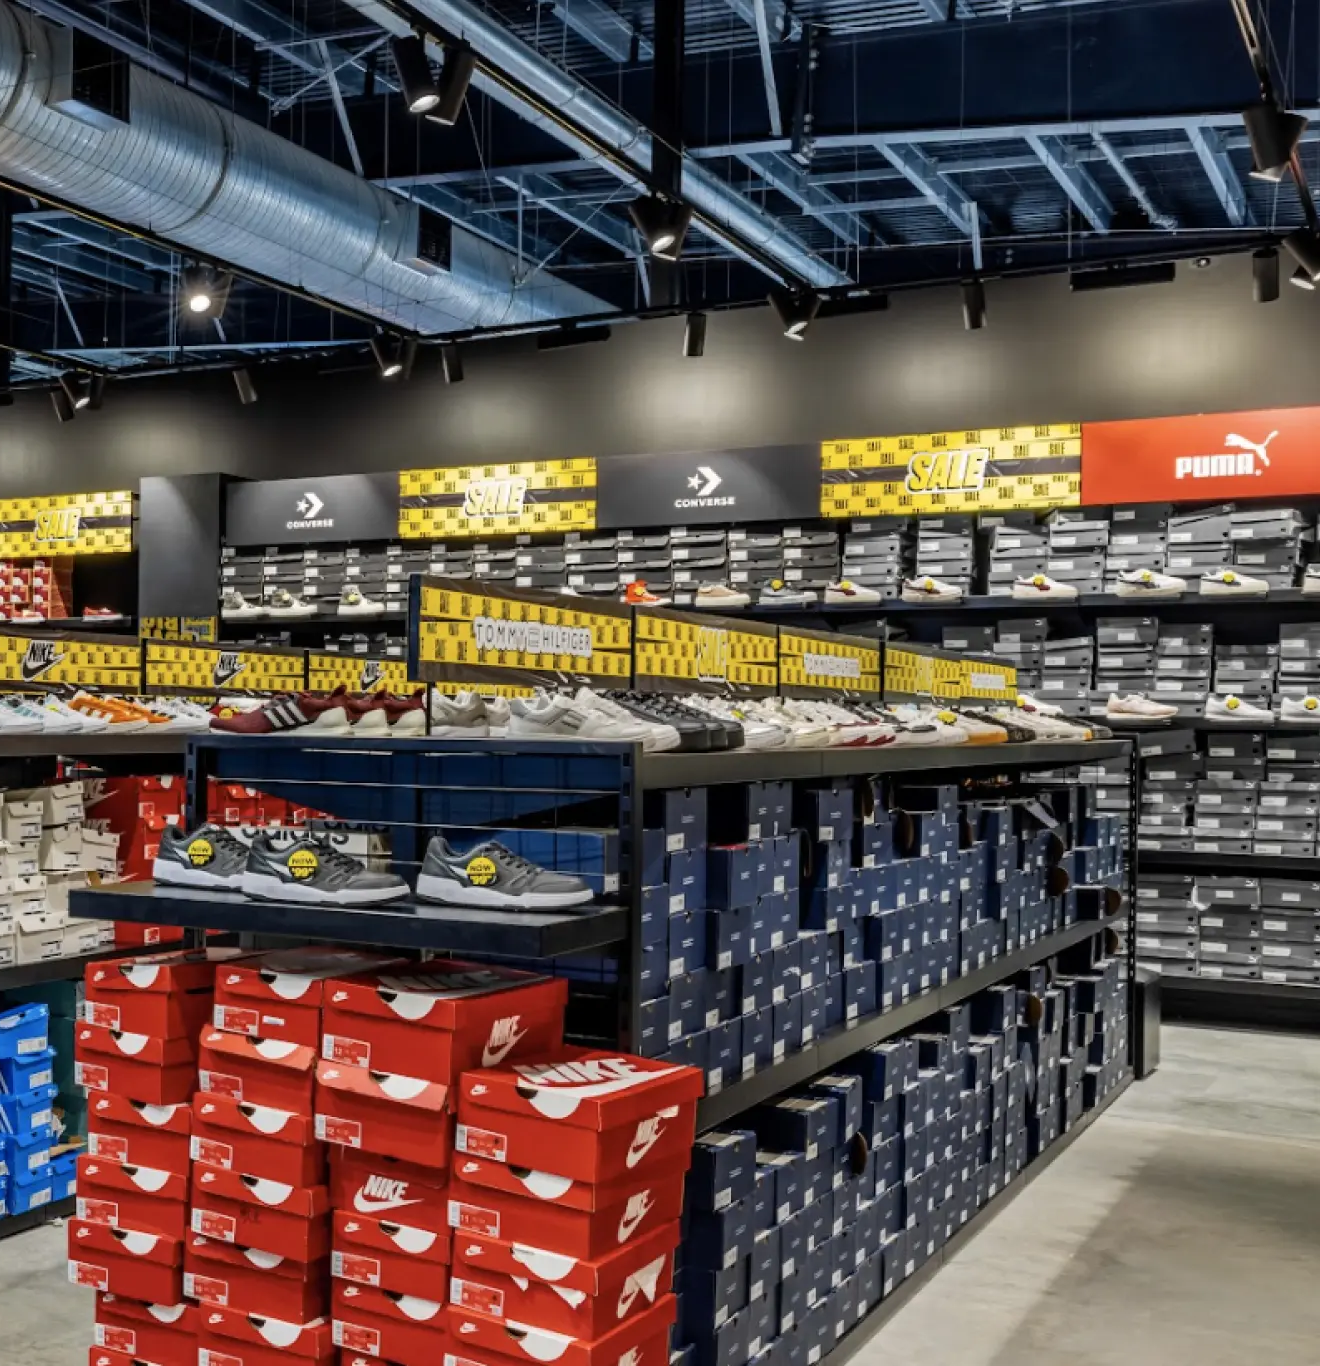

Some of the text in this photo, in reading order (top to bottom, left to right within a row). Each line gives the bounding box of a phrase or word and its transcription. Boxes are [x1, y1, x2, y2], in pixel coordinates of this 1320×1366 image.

[907, 450, 987, 491] SALE
[465, 484, 524, 517] SALE
[673, 496, 736, 508] CONVERSE
[37, 511, 79, 541] SALE
[286, 519, 334, 530] CONVERSE
[476, 623, 591, 650] TOMMY HILFIGER
[28, 641, 56, 663] NIKE
[292, 857, 314, 865] NOW
[488, 1015, 521, 1047] NIKE
[512, 1058, 637, 1085] NIKE
[364, 1174, 410, 1201] NIKE
